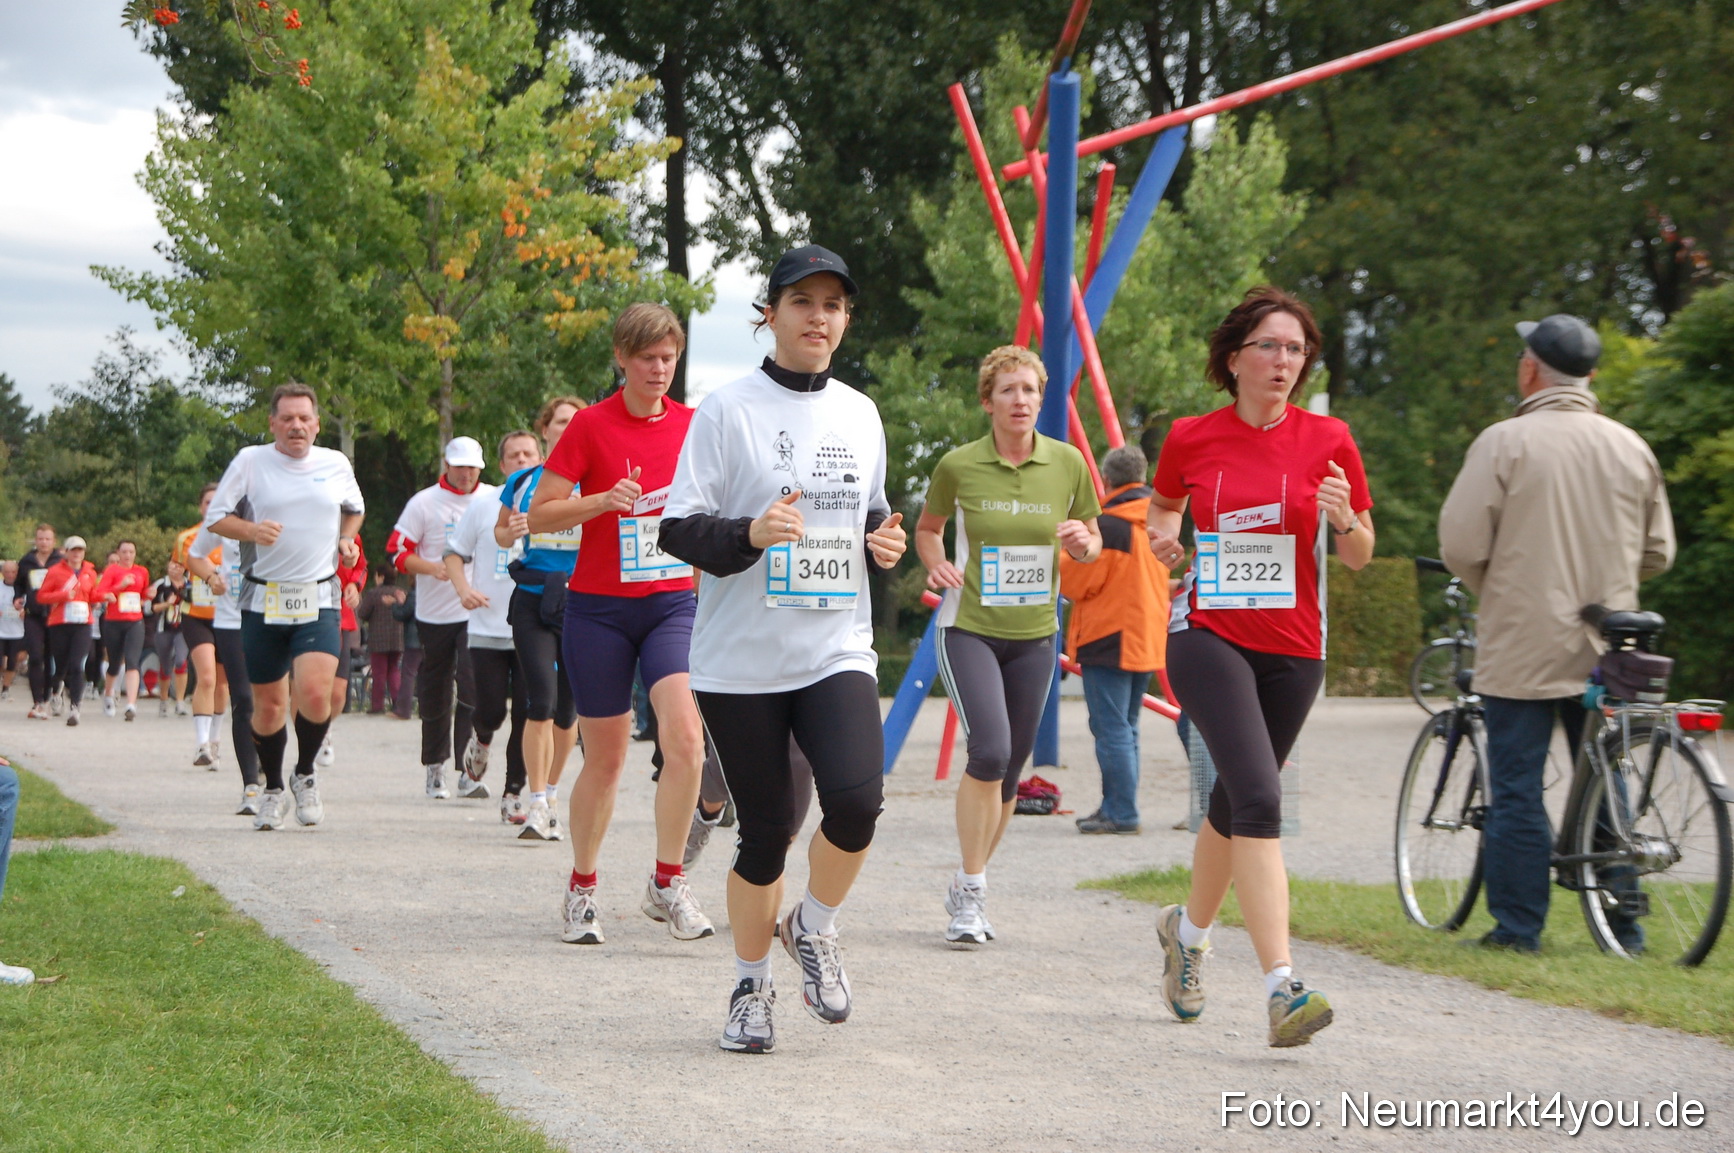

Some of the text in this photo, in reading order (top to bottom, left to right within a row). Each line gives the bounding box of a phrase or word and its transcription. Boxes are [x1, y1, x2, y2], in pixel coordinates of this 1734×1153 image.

[800, 489, 860, 500] Neumarkter
[813, 499, 860, 511] Stadtlauf
[982, 499, 1052, 514] EURO POLES
[1236, 513, 1264, 525] DEHN
[797, 534, 852, 550] Alexandra
[1225, 540, 1273, 554] Susanne
[774, 556, 781, 568] C
[1004, 551, 1038, 562] Ramona
[798, 558, 851, 580] 3401
[1203, 561, 1209, 572] C
[1225, 562, 1283, 582] 2322
[1005, 568, 1045, 584] 2228
[285, 598, 308, 610] 601
